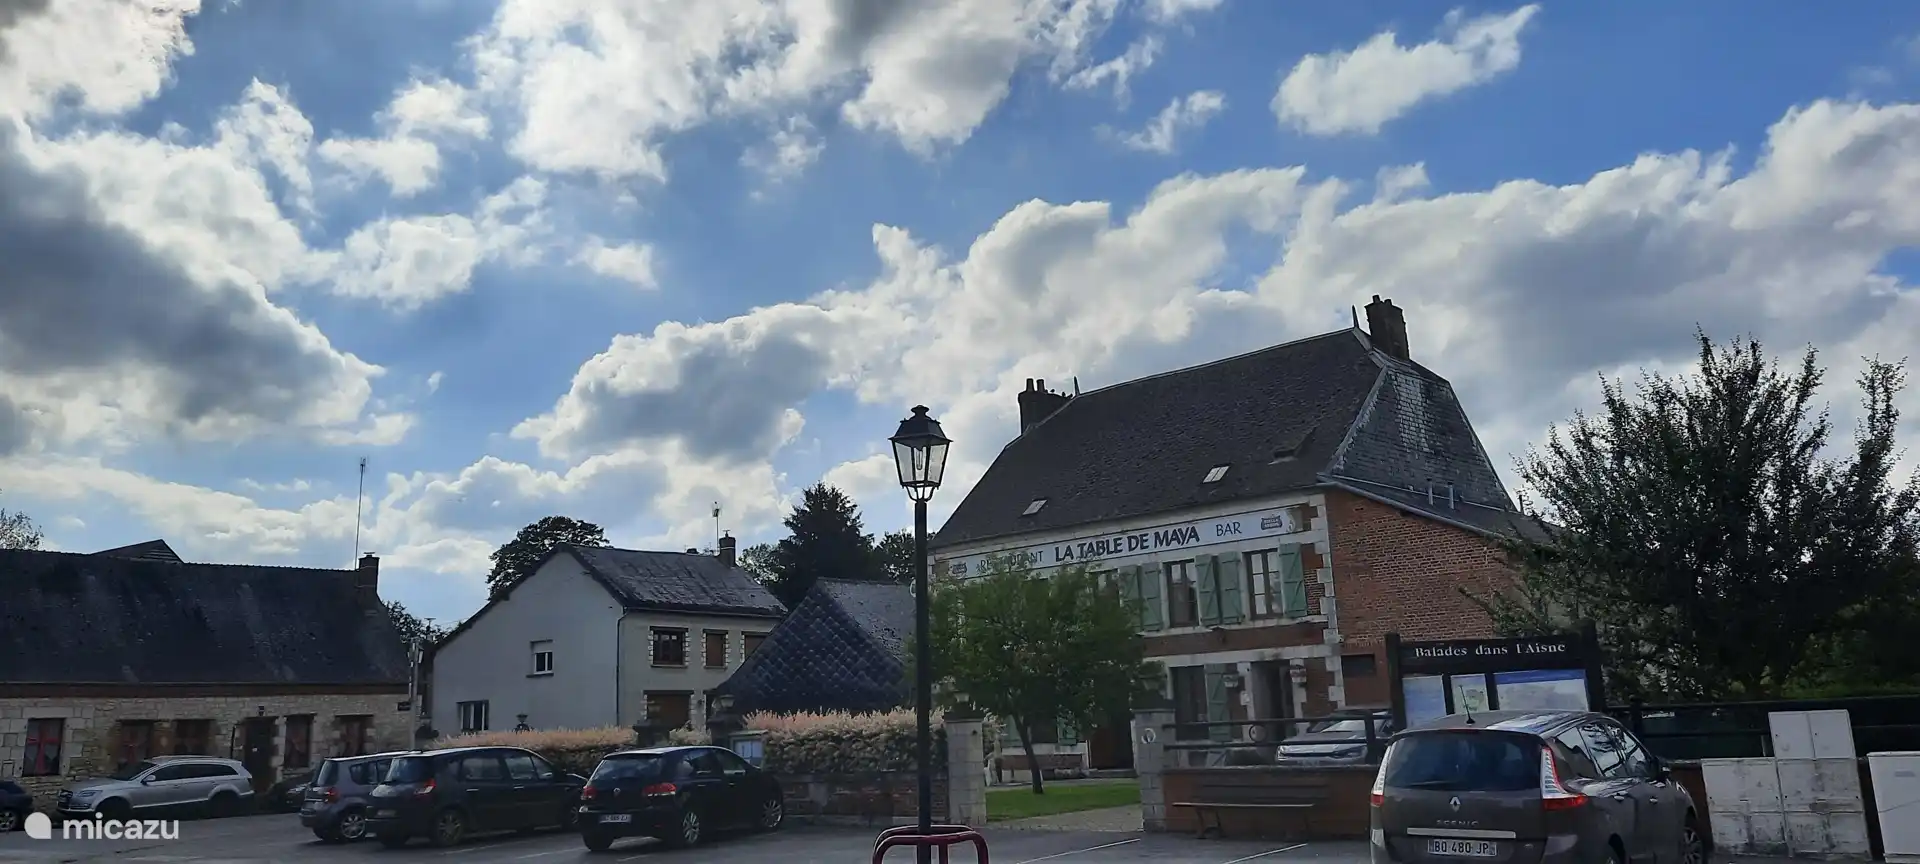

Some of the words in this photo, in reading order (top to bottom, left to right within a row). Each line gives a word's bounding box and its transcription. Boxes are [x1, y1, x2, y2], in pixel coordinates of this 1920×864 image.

[1055, 545, 1074, 562] LA
[1077, 536, 1123, 559] TABLE
[1126, 533, 1149, 552] DE
[1154, 525, 1200, 549] MAYA
[1216, 521, 1242, 537] BAR
[1415, 646, 1467, 658] Balades
[1475, 644, 1508, 656] dans
[1451, 841, 1471, 854] 480
[1476, 842, 1489, 855] JP
